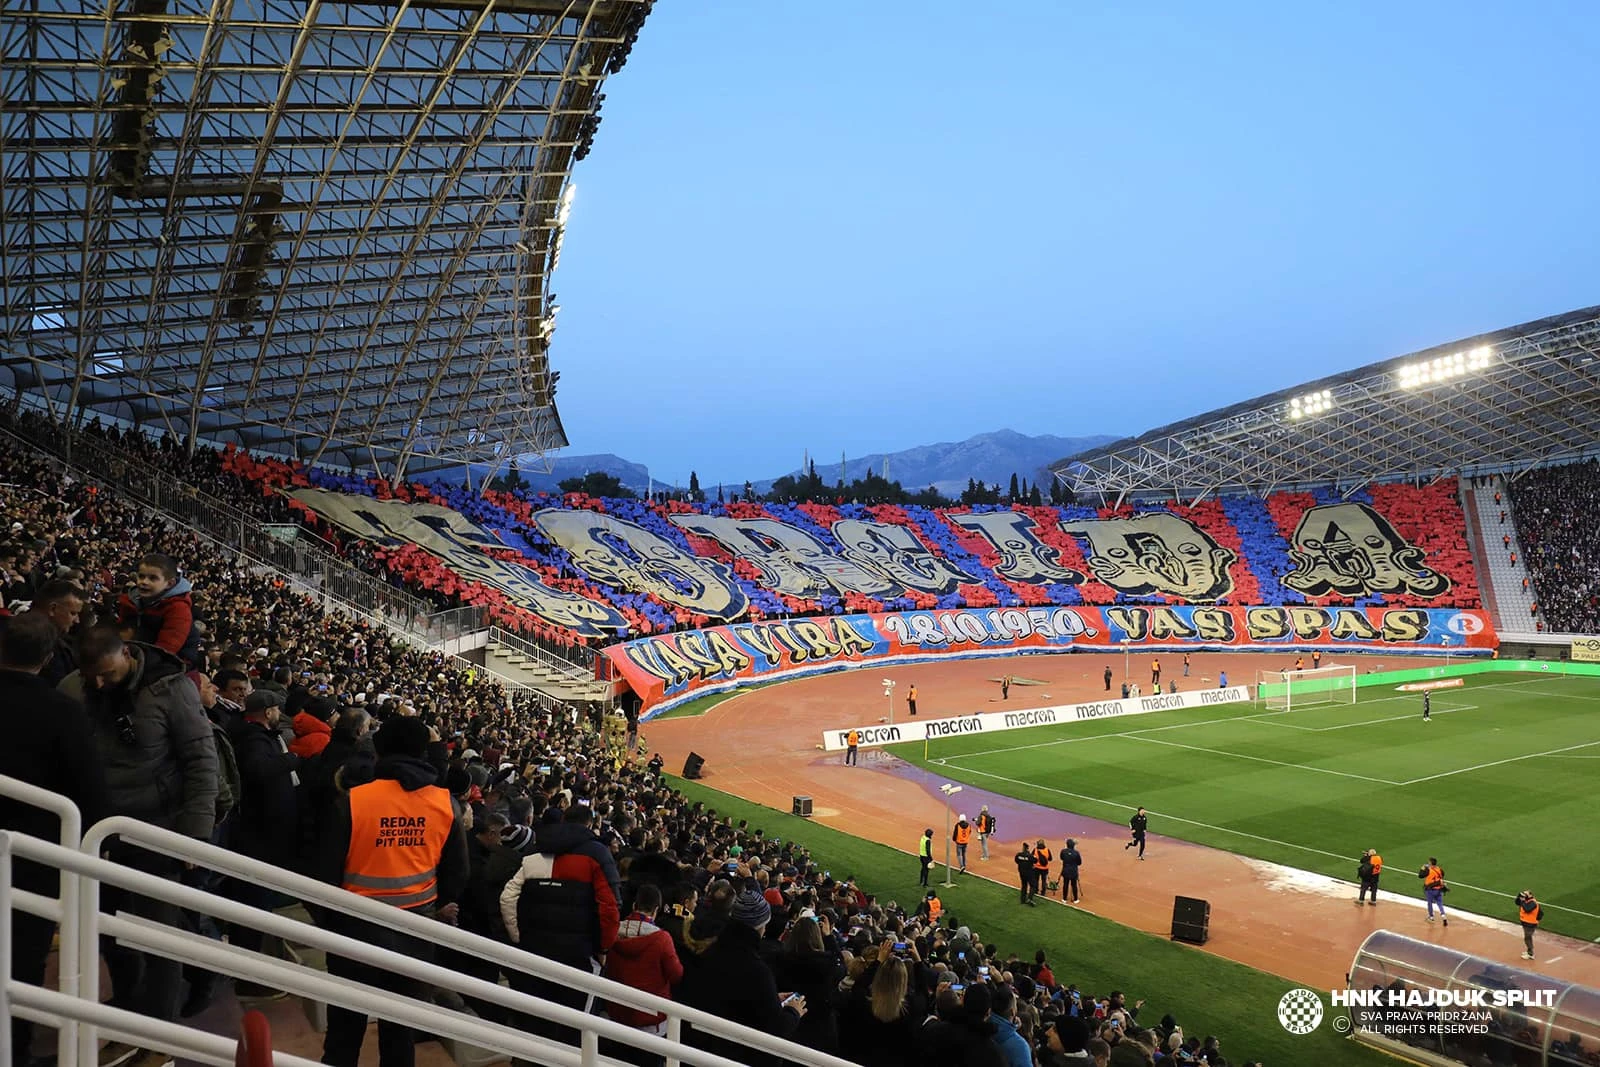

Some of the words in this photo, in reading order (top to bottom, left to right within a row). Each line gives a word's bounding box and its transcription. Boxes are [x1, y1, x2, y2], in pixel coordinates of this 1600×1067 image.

[624, 631, 749, 691] VAŠA
[735, 618, 874, 664] VIRA
[885, 608, 1098, 645] 28.10.1950.
[1107, 607, 1235, 641] VAŠ
[1248, 608, 1429, 641] SPAS
[1141, 693, 1185, 711] macron
[1200, 687, 1241, 704] macron
[1005, 709, 1056, 728] macron
[1076, 701, 1123, 719] macron
[926, 717, 982, 737] macron
[380, 816, 426, 828] REDAR
[375, 838, 395, 847] PIT
[398, 837, 426, 847] BULL
[380, 829, 425, 837] SECURITY
